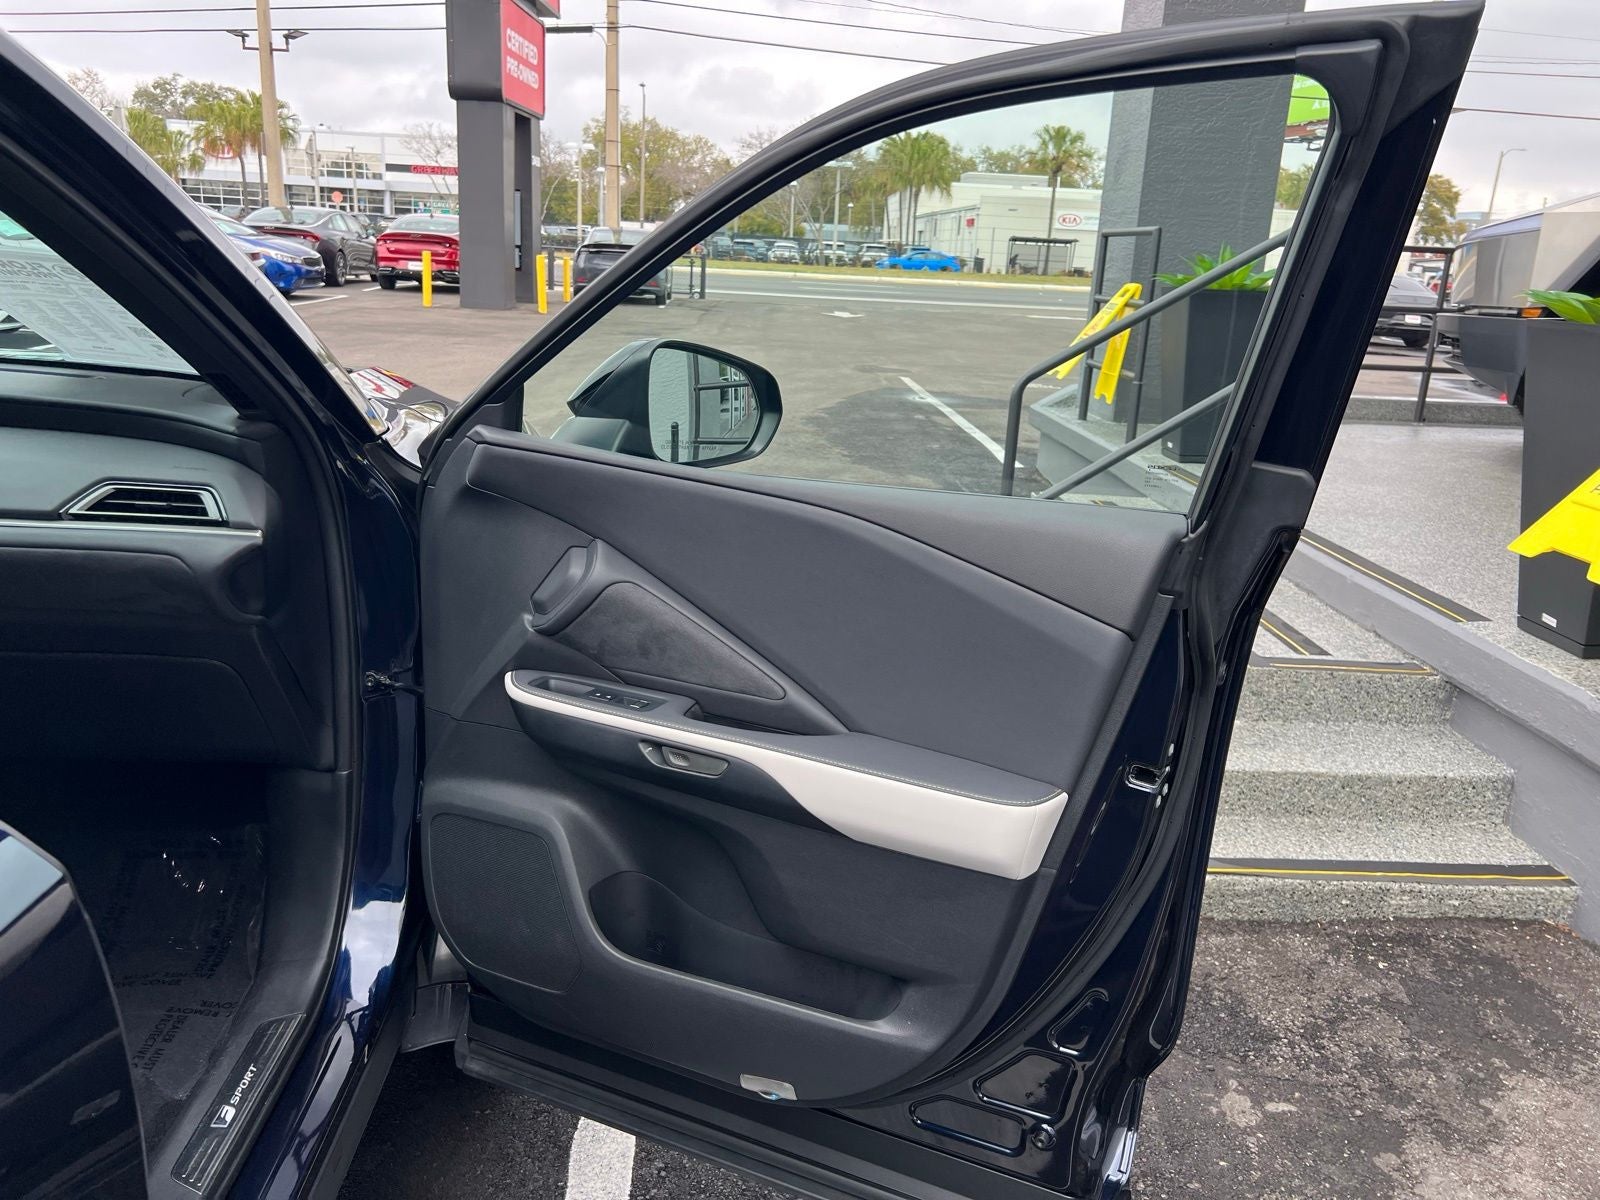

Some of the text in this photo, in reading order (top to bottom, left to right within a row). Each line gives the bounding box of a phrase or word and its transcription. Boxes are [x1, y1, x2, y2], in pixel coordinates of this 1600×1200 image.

[506, 27, 538, 65] CERTIFIED
[506, 55, 539, 90] PRE-OWNED
[1061, 216, 1078, 224] KIA
[230, 1063, 257, 1106] SPORT
